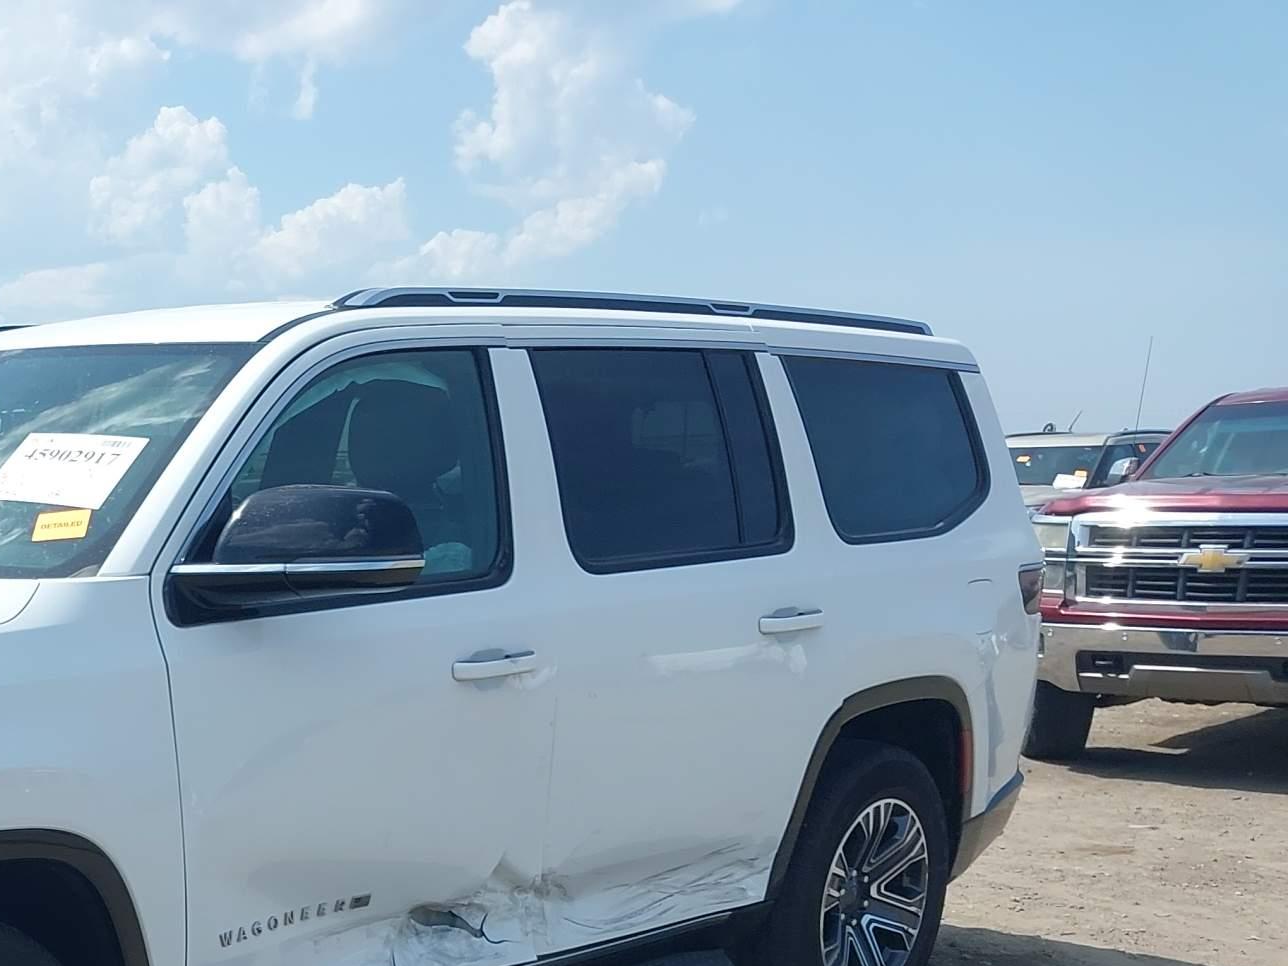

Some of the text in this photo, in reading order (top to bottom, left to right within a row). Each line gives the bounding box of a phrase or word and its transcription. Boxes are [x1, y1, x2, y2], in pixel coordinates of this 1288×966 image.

[24, 448, 122, 466] 45902917
[40, 520, 83, 530] DETAILED
[218, 898, 346, 948] WAGONEER
